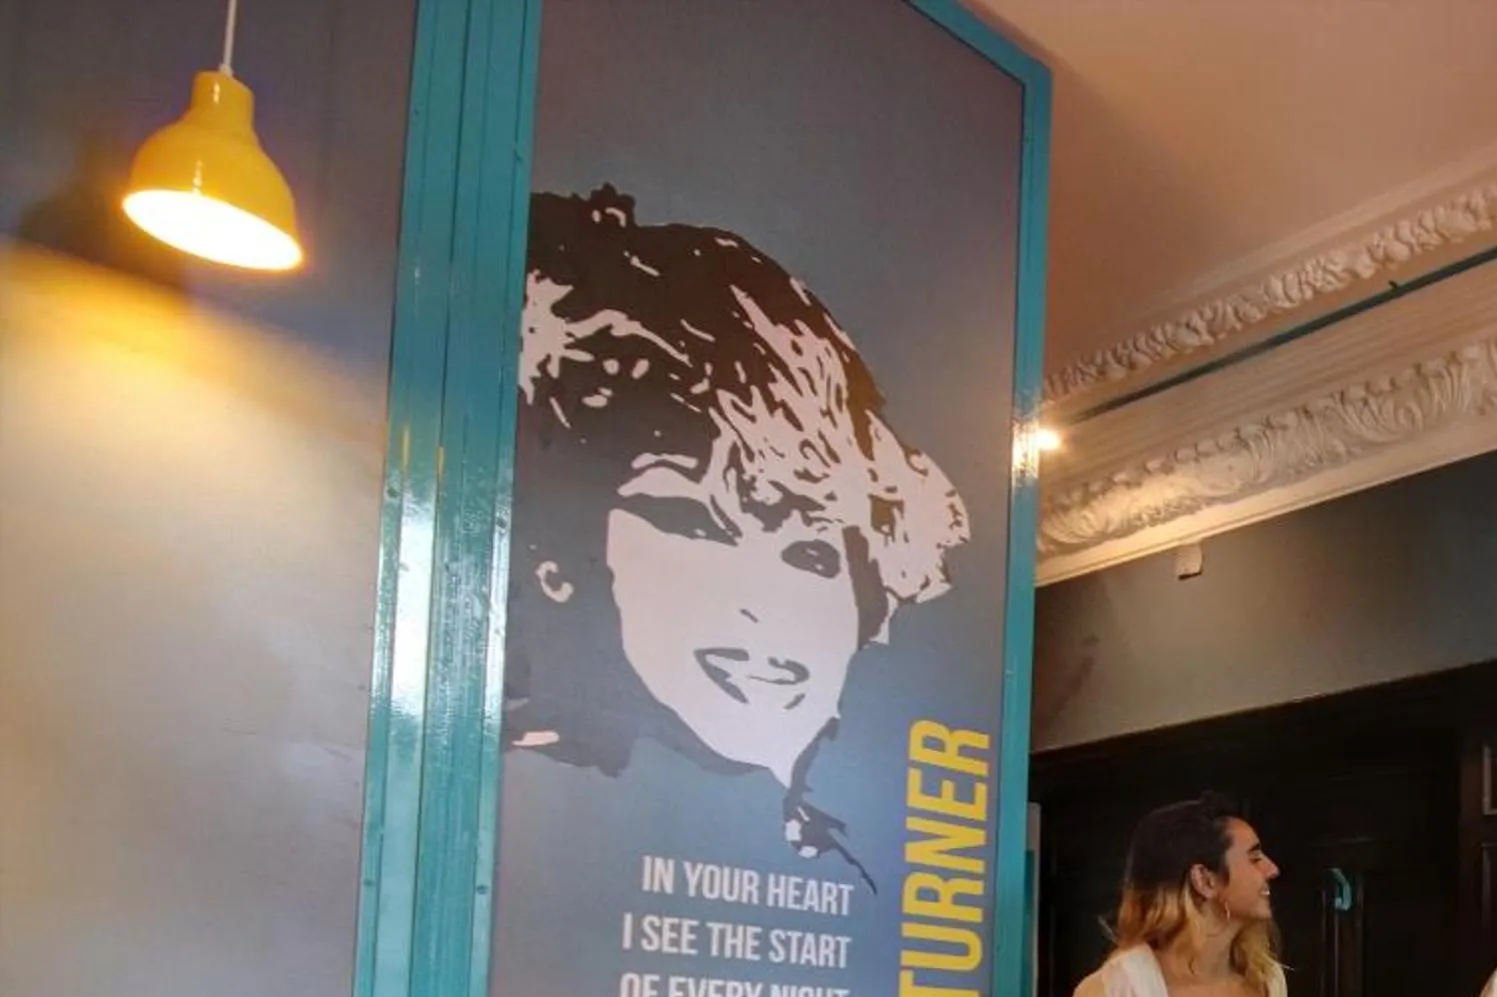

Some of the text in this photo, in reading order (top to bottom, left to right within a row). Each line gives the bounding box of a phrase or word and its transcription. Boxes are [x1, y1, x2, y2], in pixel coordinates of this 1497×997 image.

[642, 855, 854, 916] IN YOUR HEART
[622, 912, 851, 968] I SEE THE START
